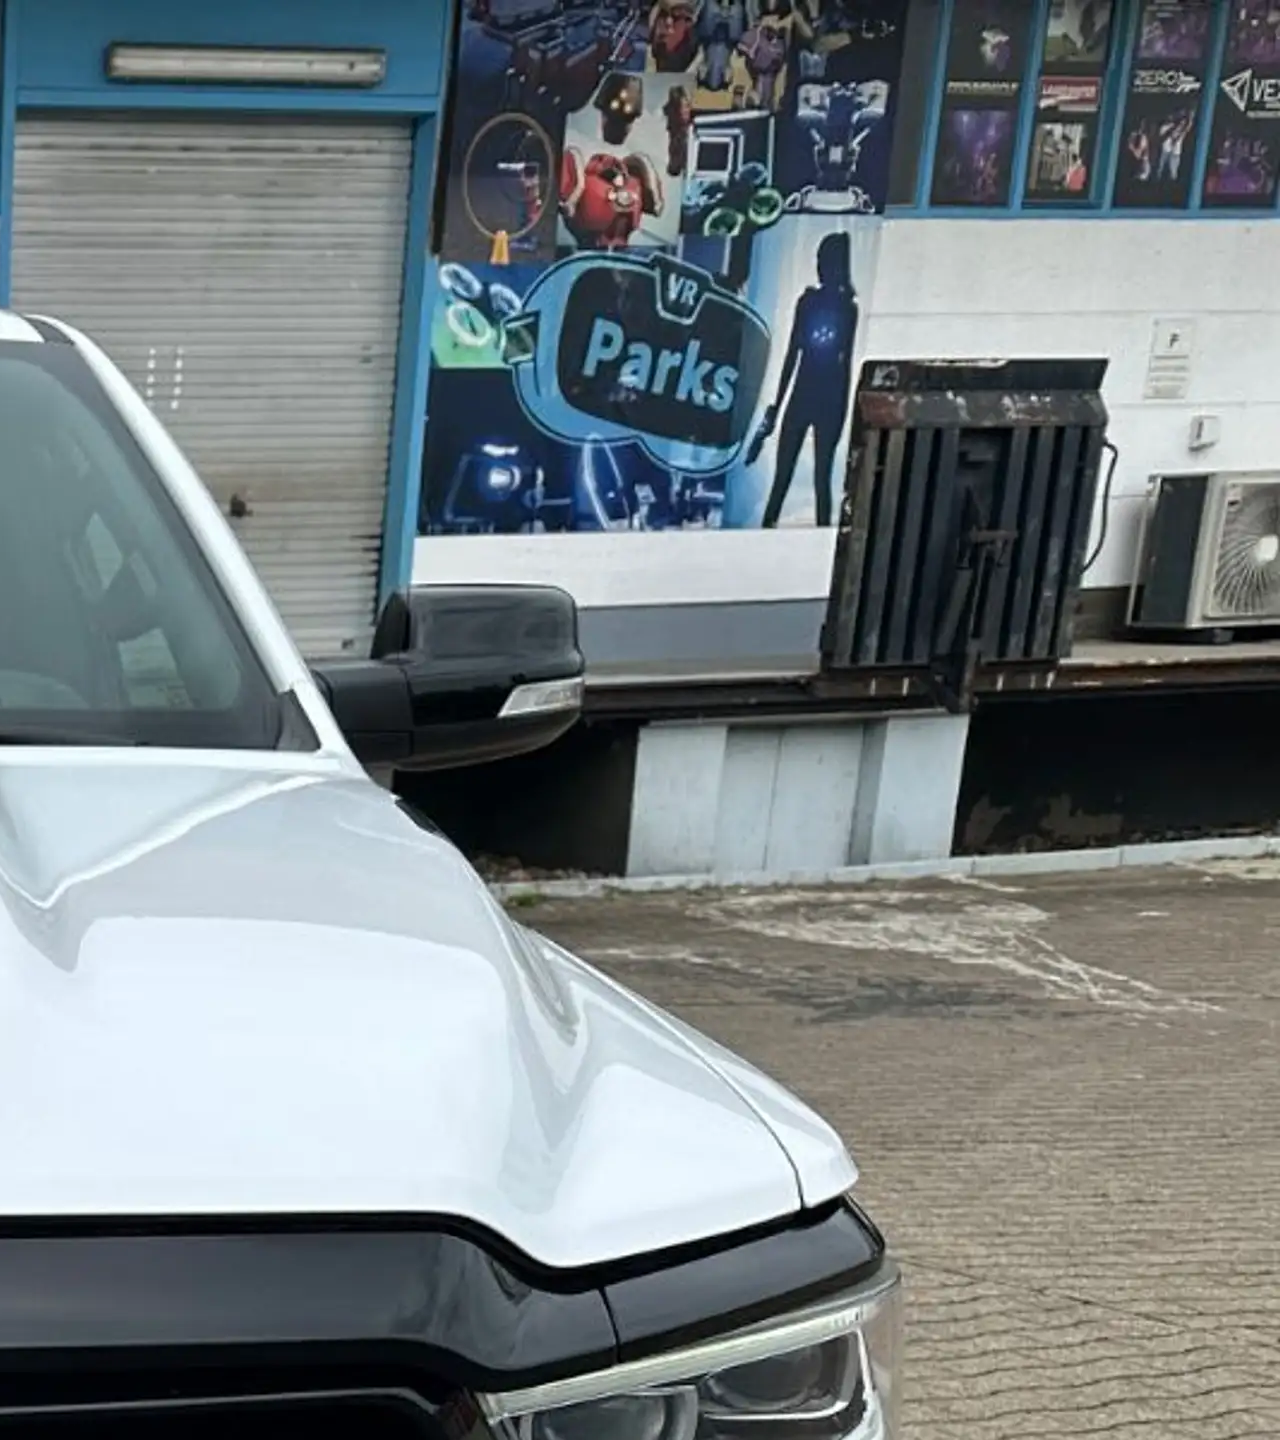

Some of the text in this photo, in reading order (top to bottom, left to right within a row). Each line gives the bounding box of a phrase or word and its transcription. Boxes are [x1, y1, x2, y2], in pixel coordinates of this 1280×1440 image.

[1253, 79, 1280, 102] VE
[668, 272, 699, 305] VR
[583, 317, 740, 412] Parks
